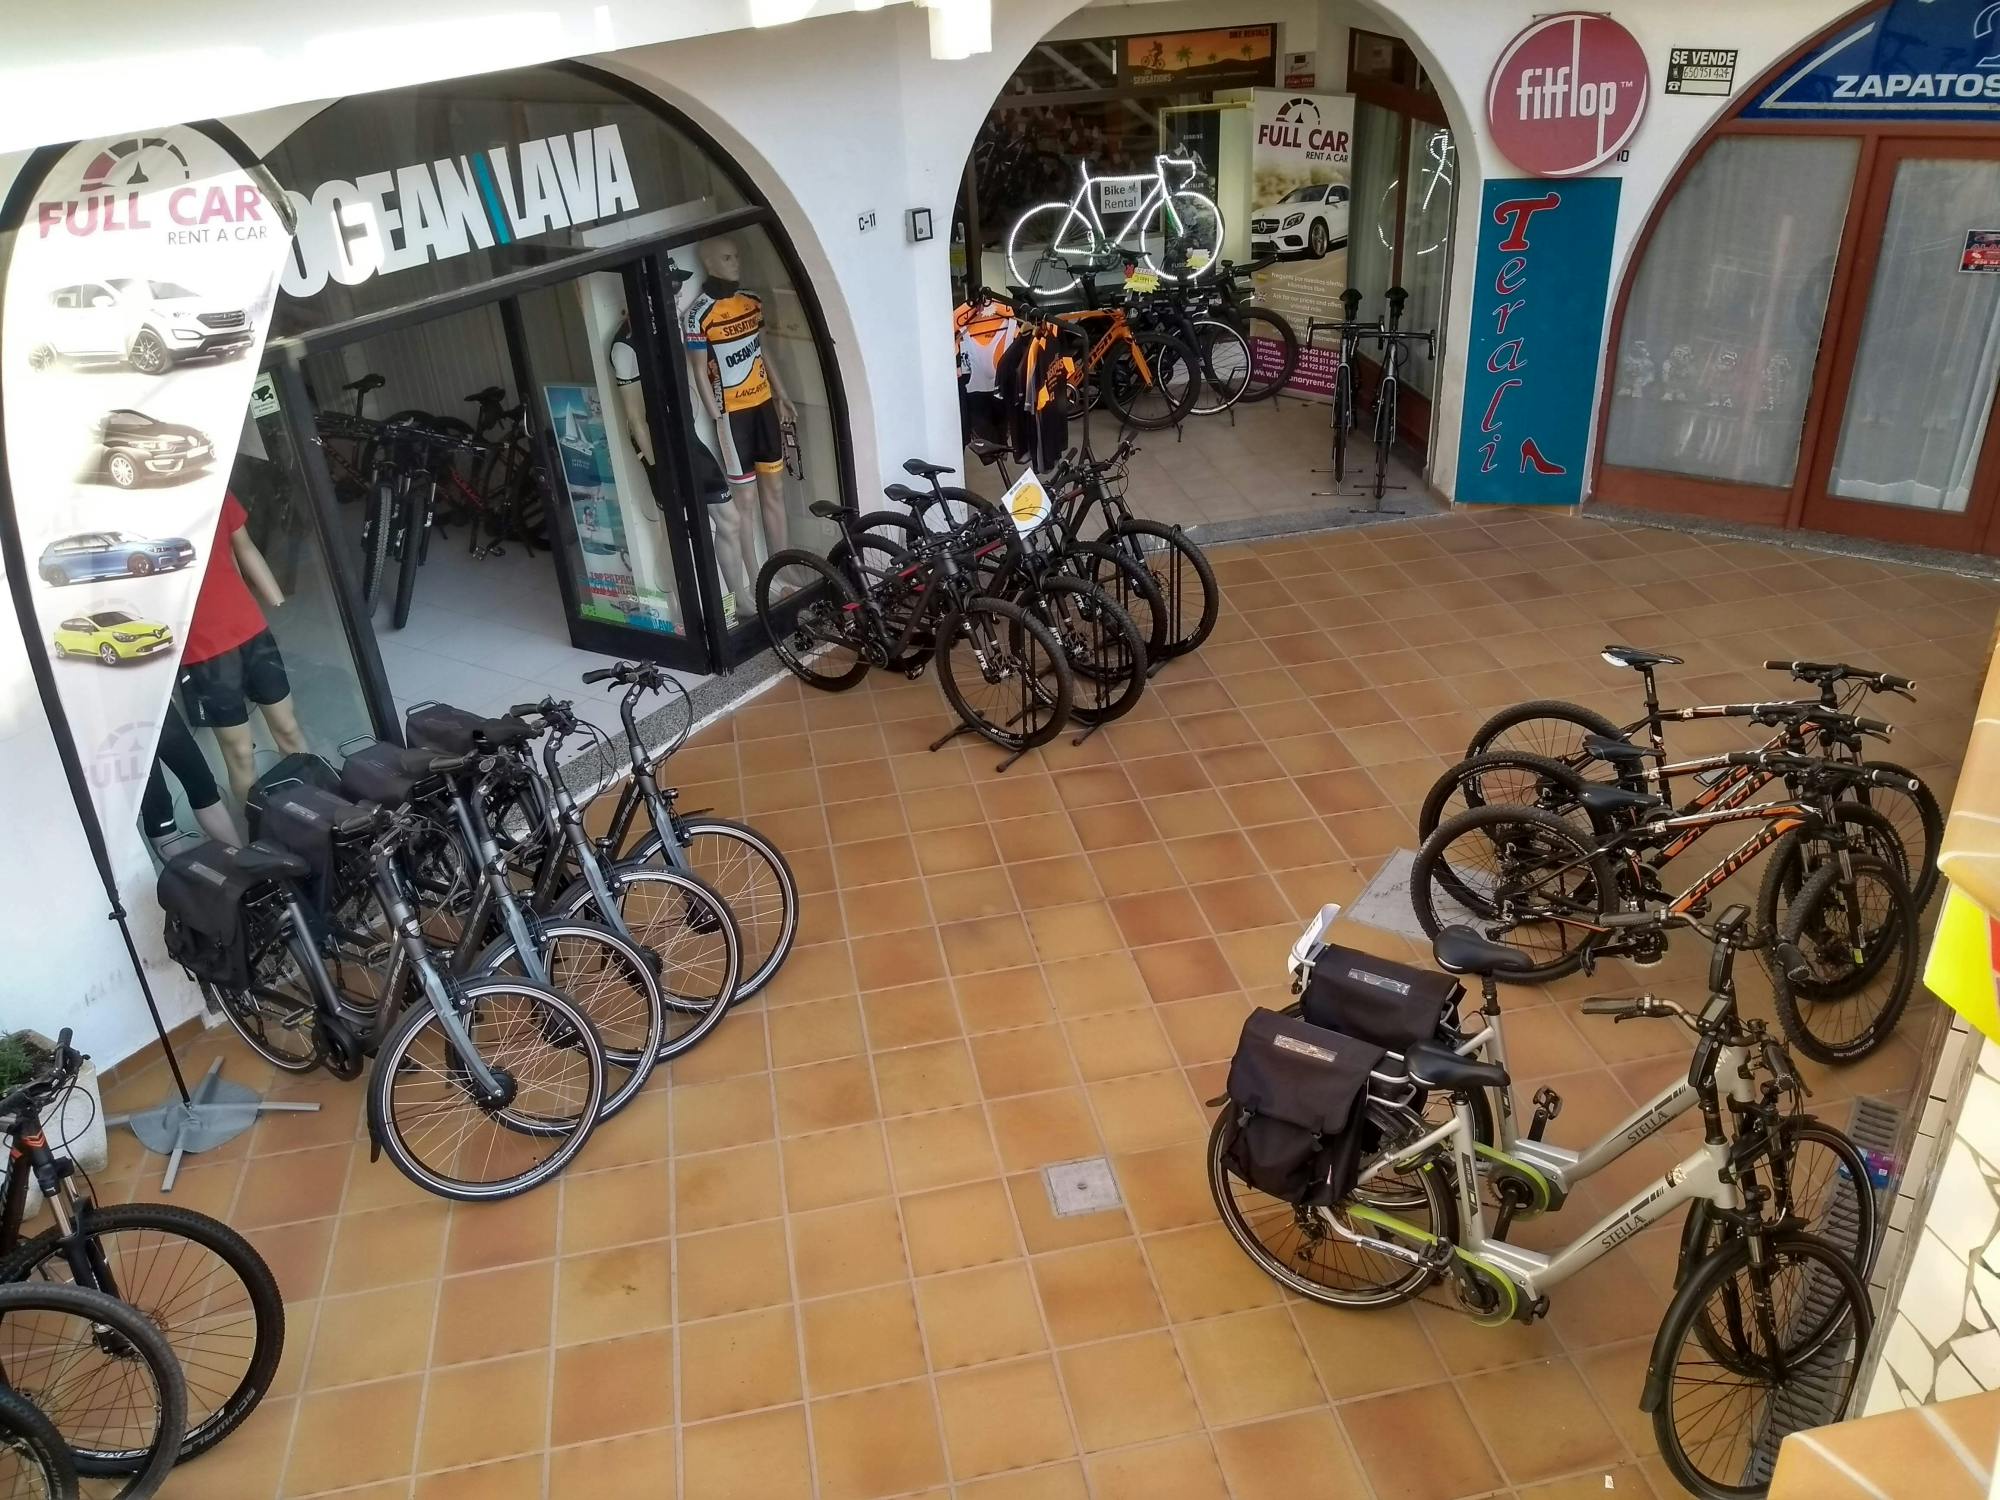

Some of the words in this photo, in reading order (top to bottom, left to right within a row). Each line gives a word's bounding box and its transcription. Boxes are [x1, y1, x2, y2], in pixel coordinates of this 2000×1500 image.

[1671, 50, 1689, 65] SE
[1692, 51, 1736, 66] VENDE
[1833, 73, 2000, 98] ZAPATOS
[1258, 124, 1302, 149] FULL
[1308, 128, 1350, 153] CAR
[1305, 151, 1325, 161] RENT
[1325, 153, 1332, 162] A
[1333, 153, 1349, 163] CAR
[1104, 185, 1126, 196] Bike
[1104, 196, 1137, 209] Rental
[38, 191, 152, 239] FULL
[168, 184, 263, 226] CAR
[279, 154, 496, 298] OCEAN
[488, 123, 640, 240] LAVA
[858, 212, 877, 231] C-11
[168, 228, 210, 246] RENT
[216, 227, 229, 243] A
[234, 225, 268, 241] CAR
[1479, 191, 1562, 473] Terali
[1627, 1110, 1670, 1144] STELLA
[1601, 1214, 1647, 1249] STELLA
